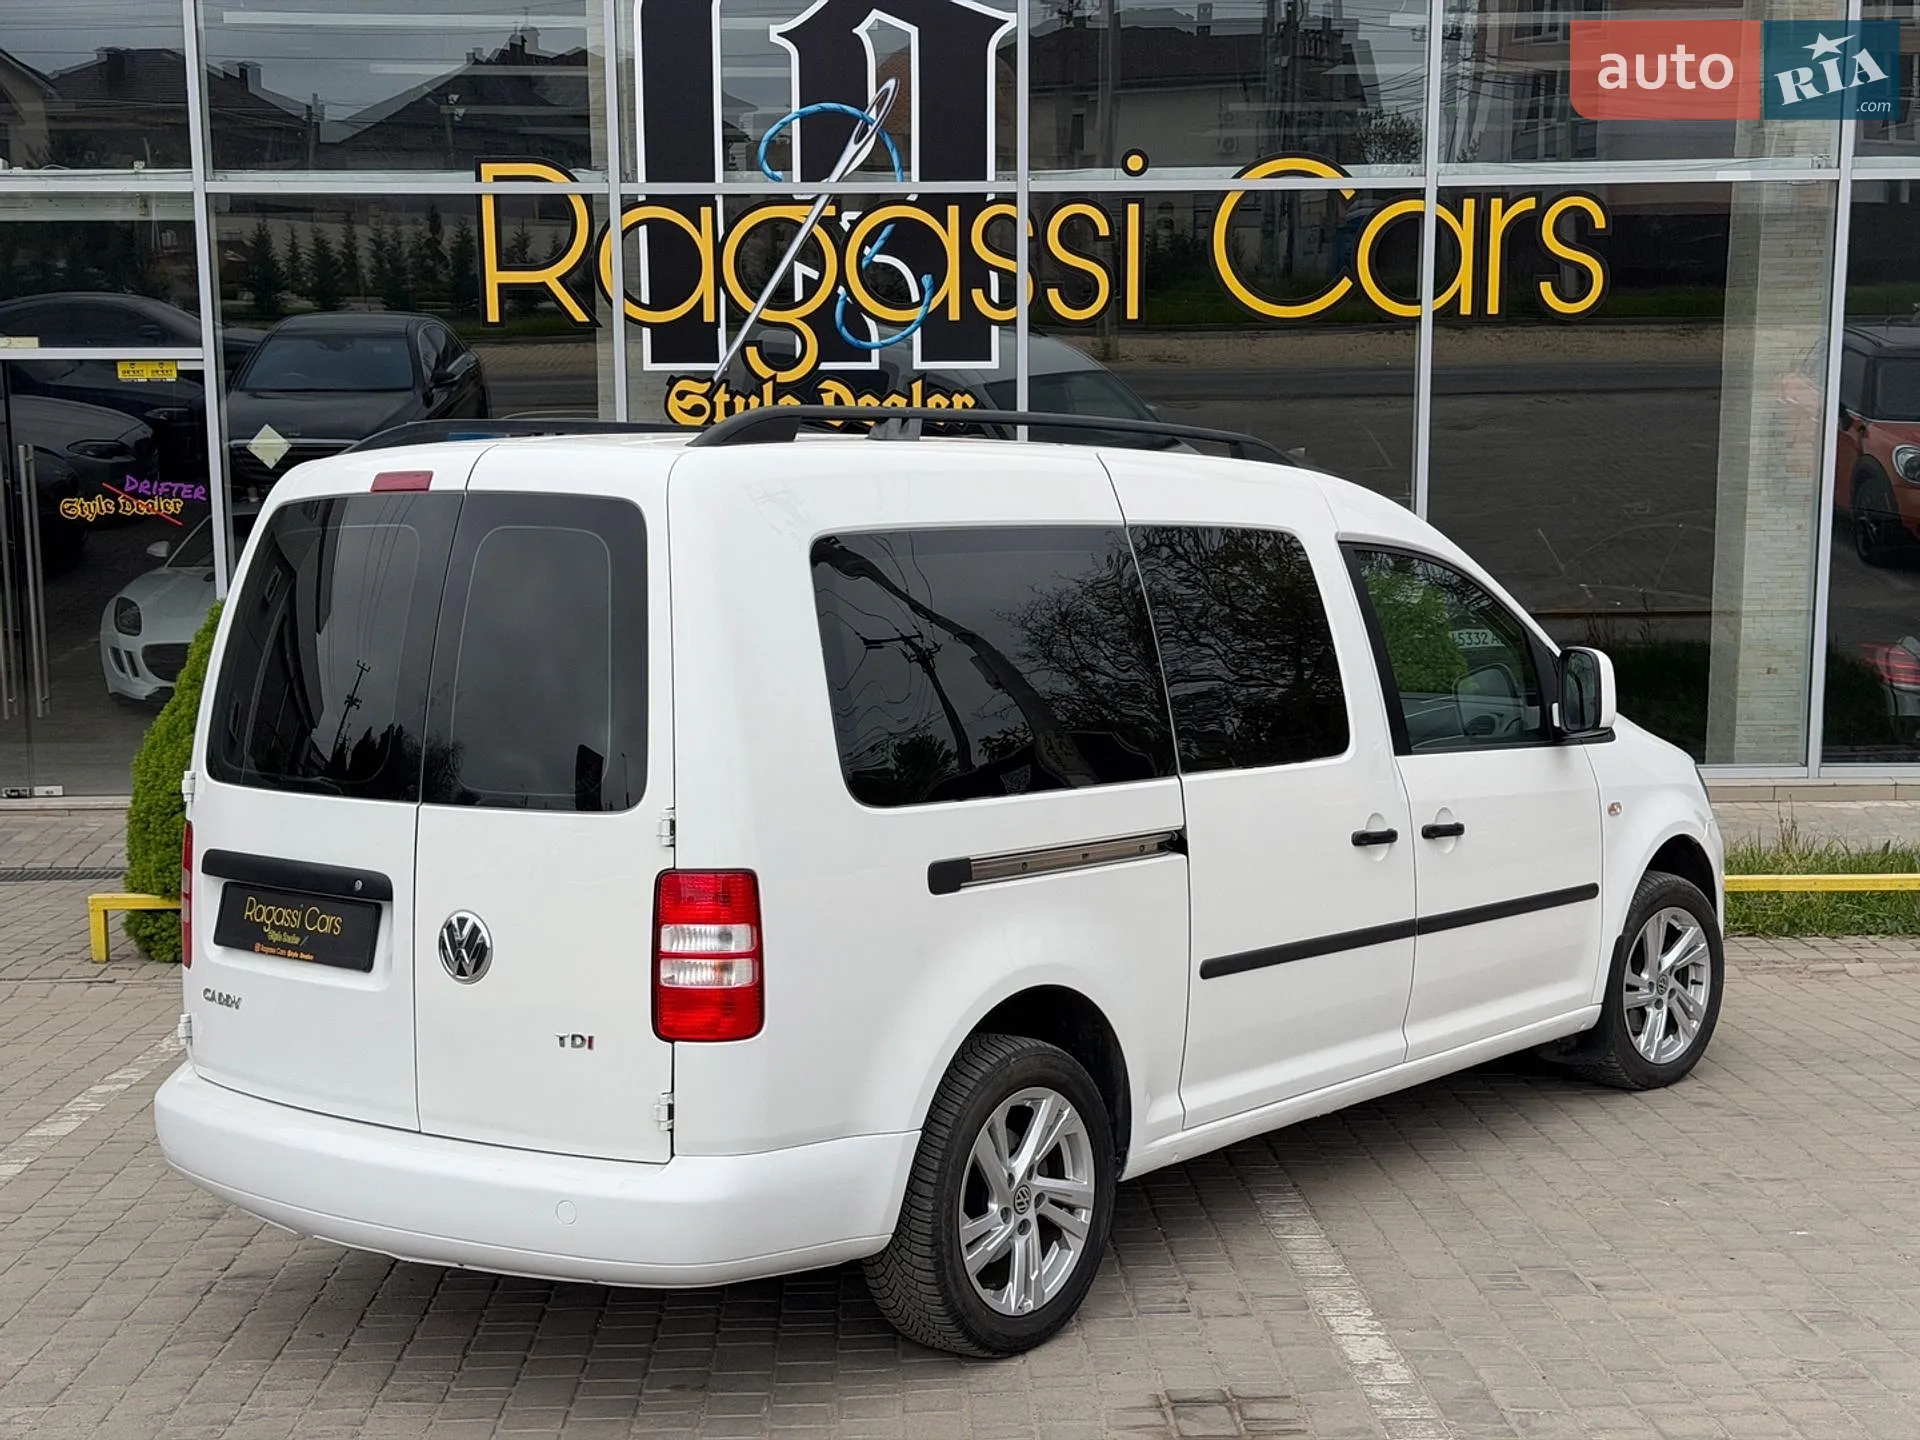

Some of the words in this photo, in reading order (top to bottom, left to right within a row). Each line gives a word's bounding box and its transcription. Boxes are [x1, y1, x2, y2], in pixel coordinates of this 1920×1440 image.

[479, 149, 1149, 384] Ragassi
[1213, 157, 1607, 318] Cars
[124, 474, 208, 501] DRIFTER
[60, 494, 116, 522] Style
[118, 494, 184, 516] Dealer
[244, 896, 304, 932] Ragassi
[304, 906, 343, 935] Cars
[202, 987, 242, 1010] CADDY
[555, 1033, 594, 1050] TDI
